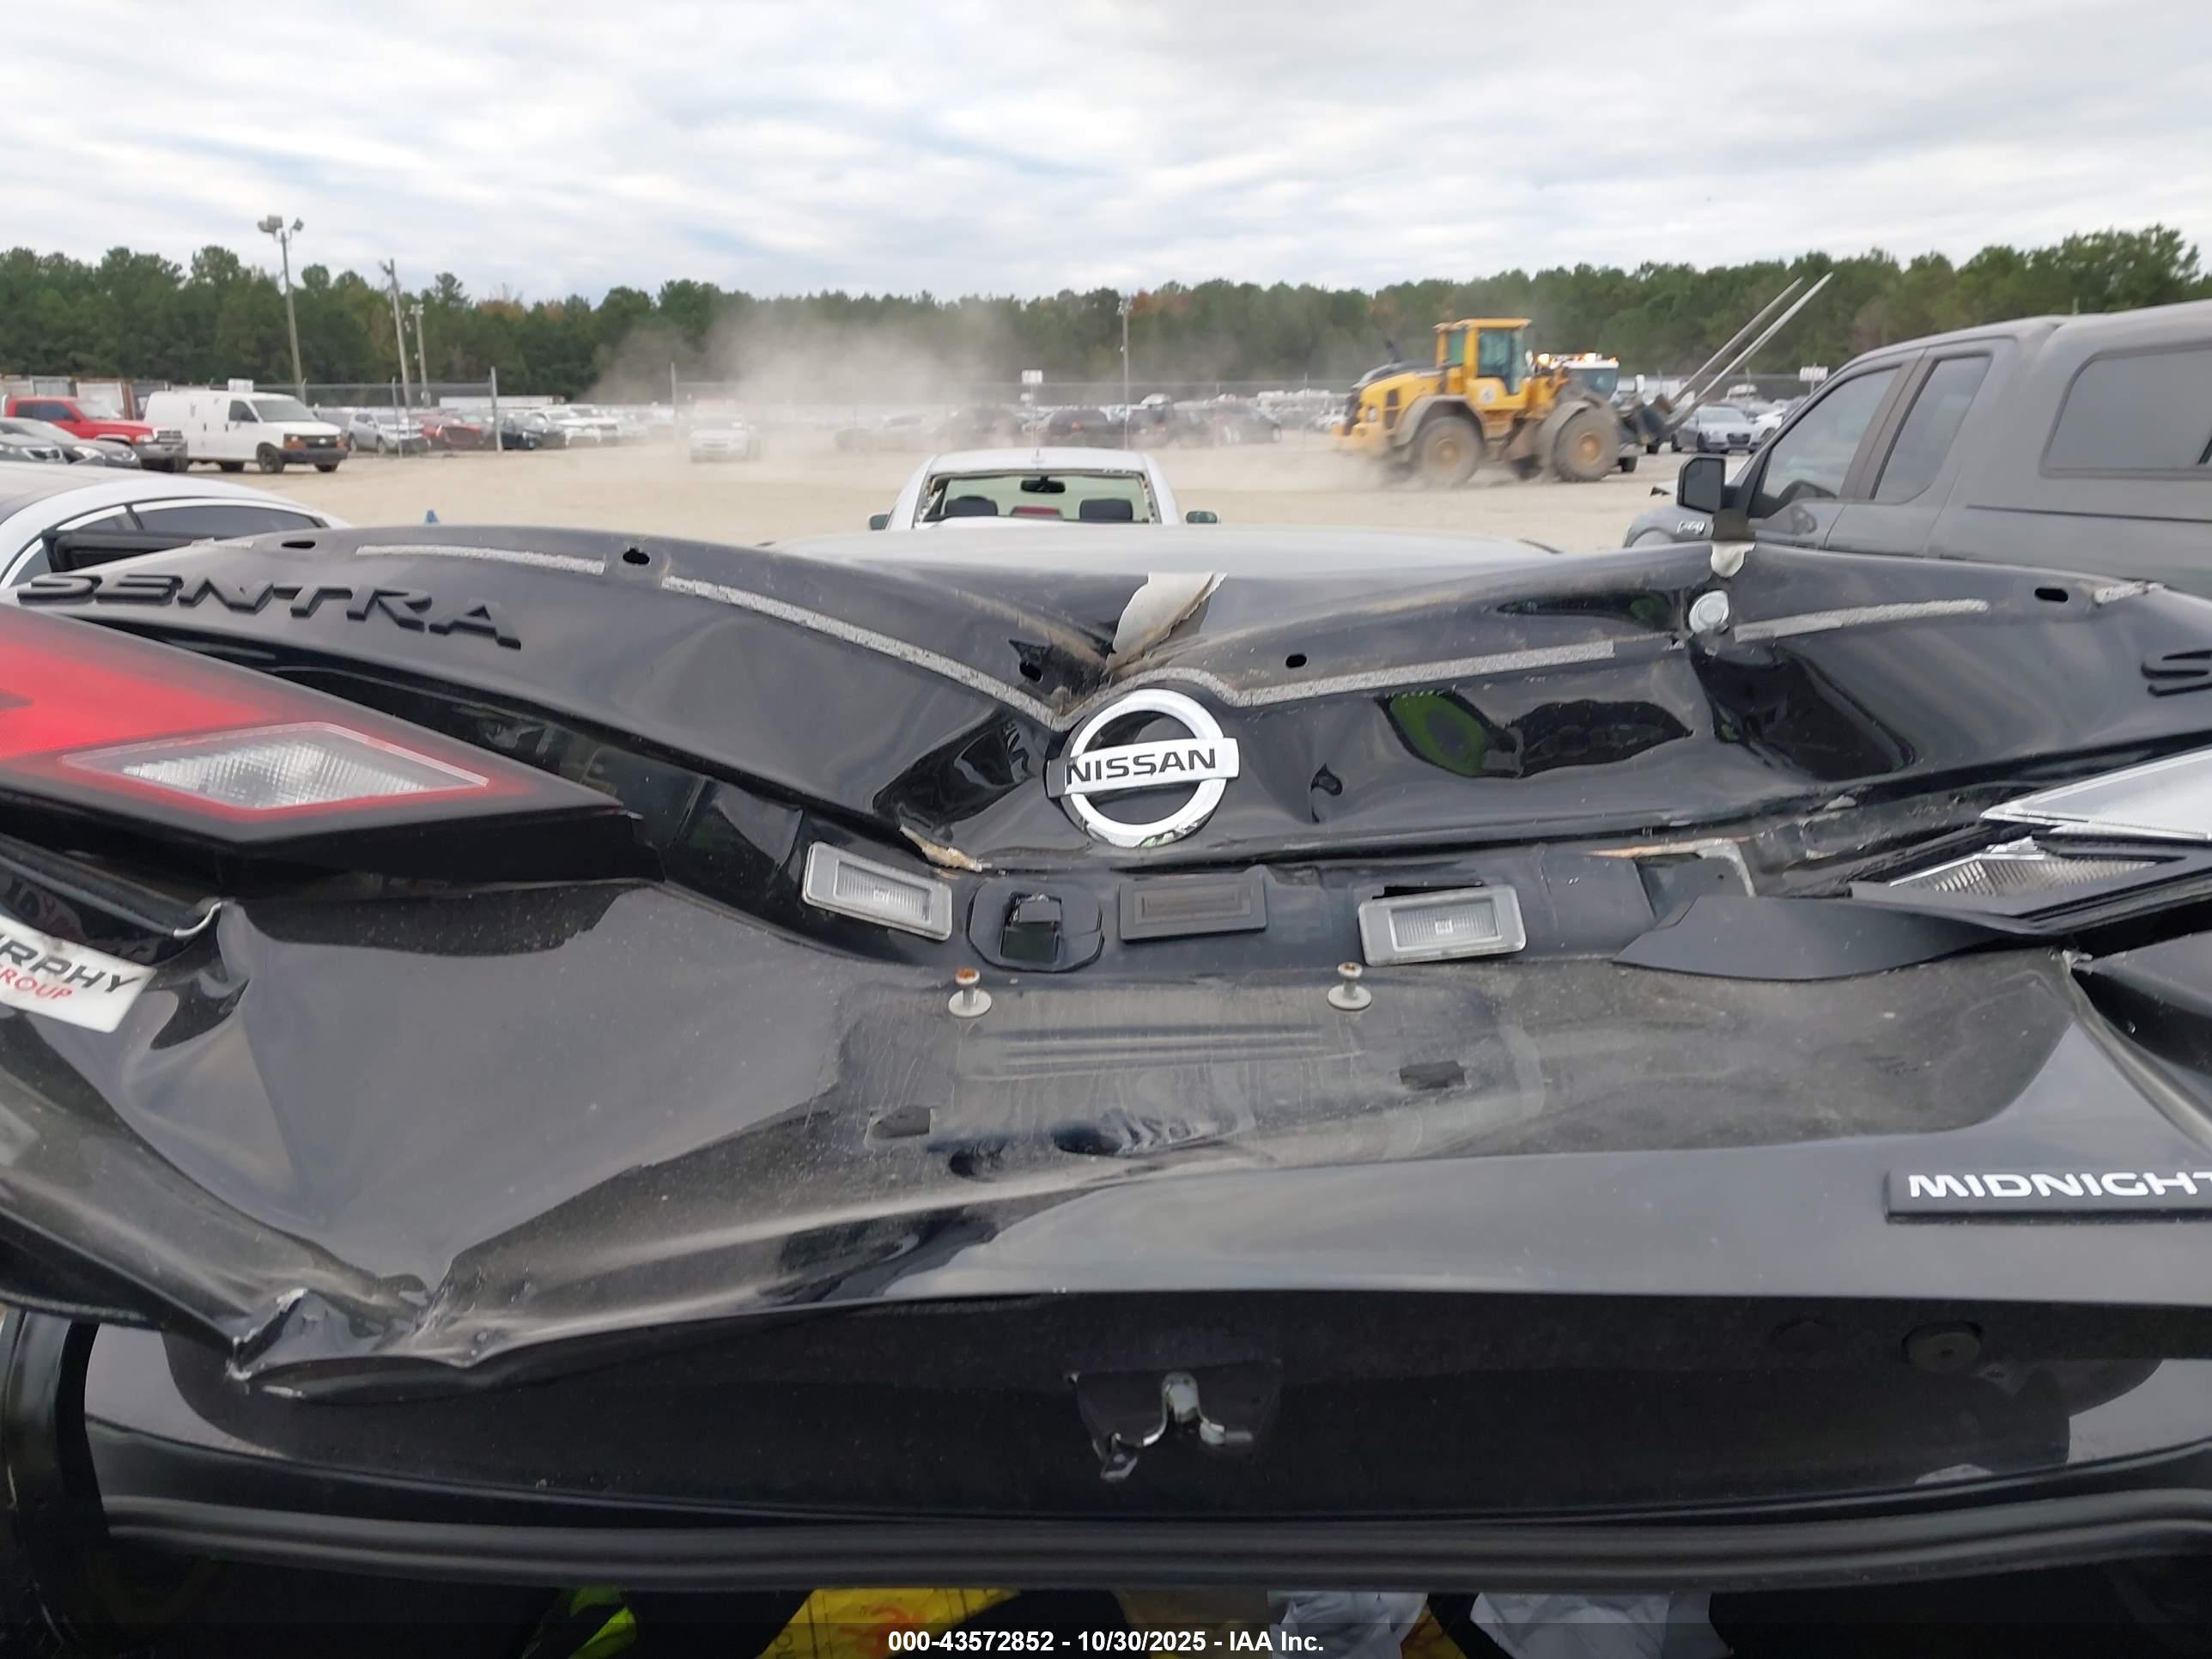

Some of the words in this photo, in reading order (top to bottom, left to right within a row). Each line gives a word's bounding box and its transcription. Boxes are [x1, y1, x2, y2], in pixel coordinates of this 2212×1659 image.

[16, 573, 522, 651] SENTRA
[1066, 748, 1217, 785] NISSAN
[0, 933, 140, 994] RPHY
[0, 963, 73, 1000] ROUP
